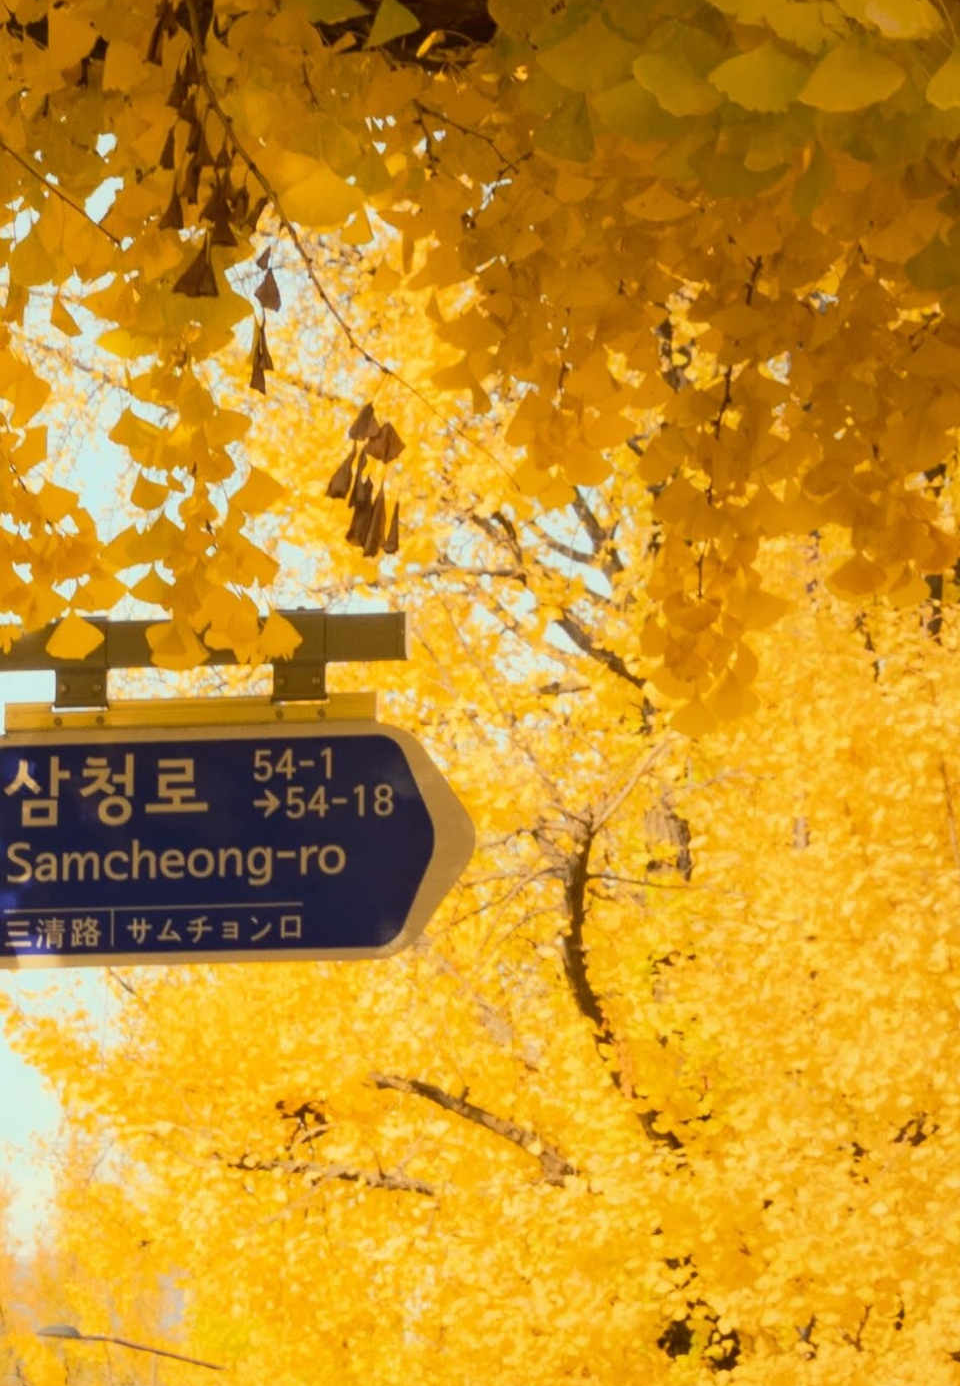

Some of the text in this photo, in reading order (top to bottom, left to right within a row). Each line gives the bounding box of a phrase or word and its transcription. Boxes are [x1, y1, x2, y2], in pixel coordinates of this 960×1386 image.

[254, 747, 333, 782] 54-1
[4, 754, 209, 827] 삼청로
[286, 783, 395, 819] 54-18
[6, 839, 346, 885] Samcheong-ro
[4, 915, 102, 950] 三清路
[127, 913, 303, 944] サムチョンロ
